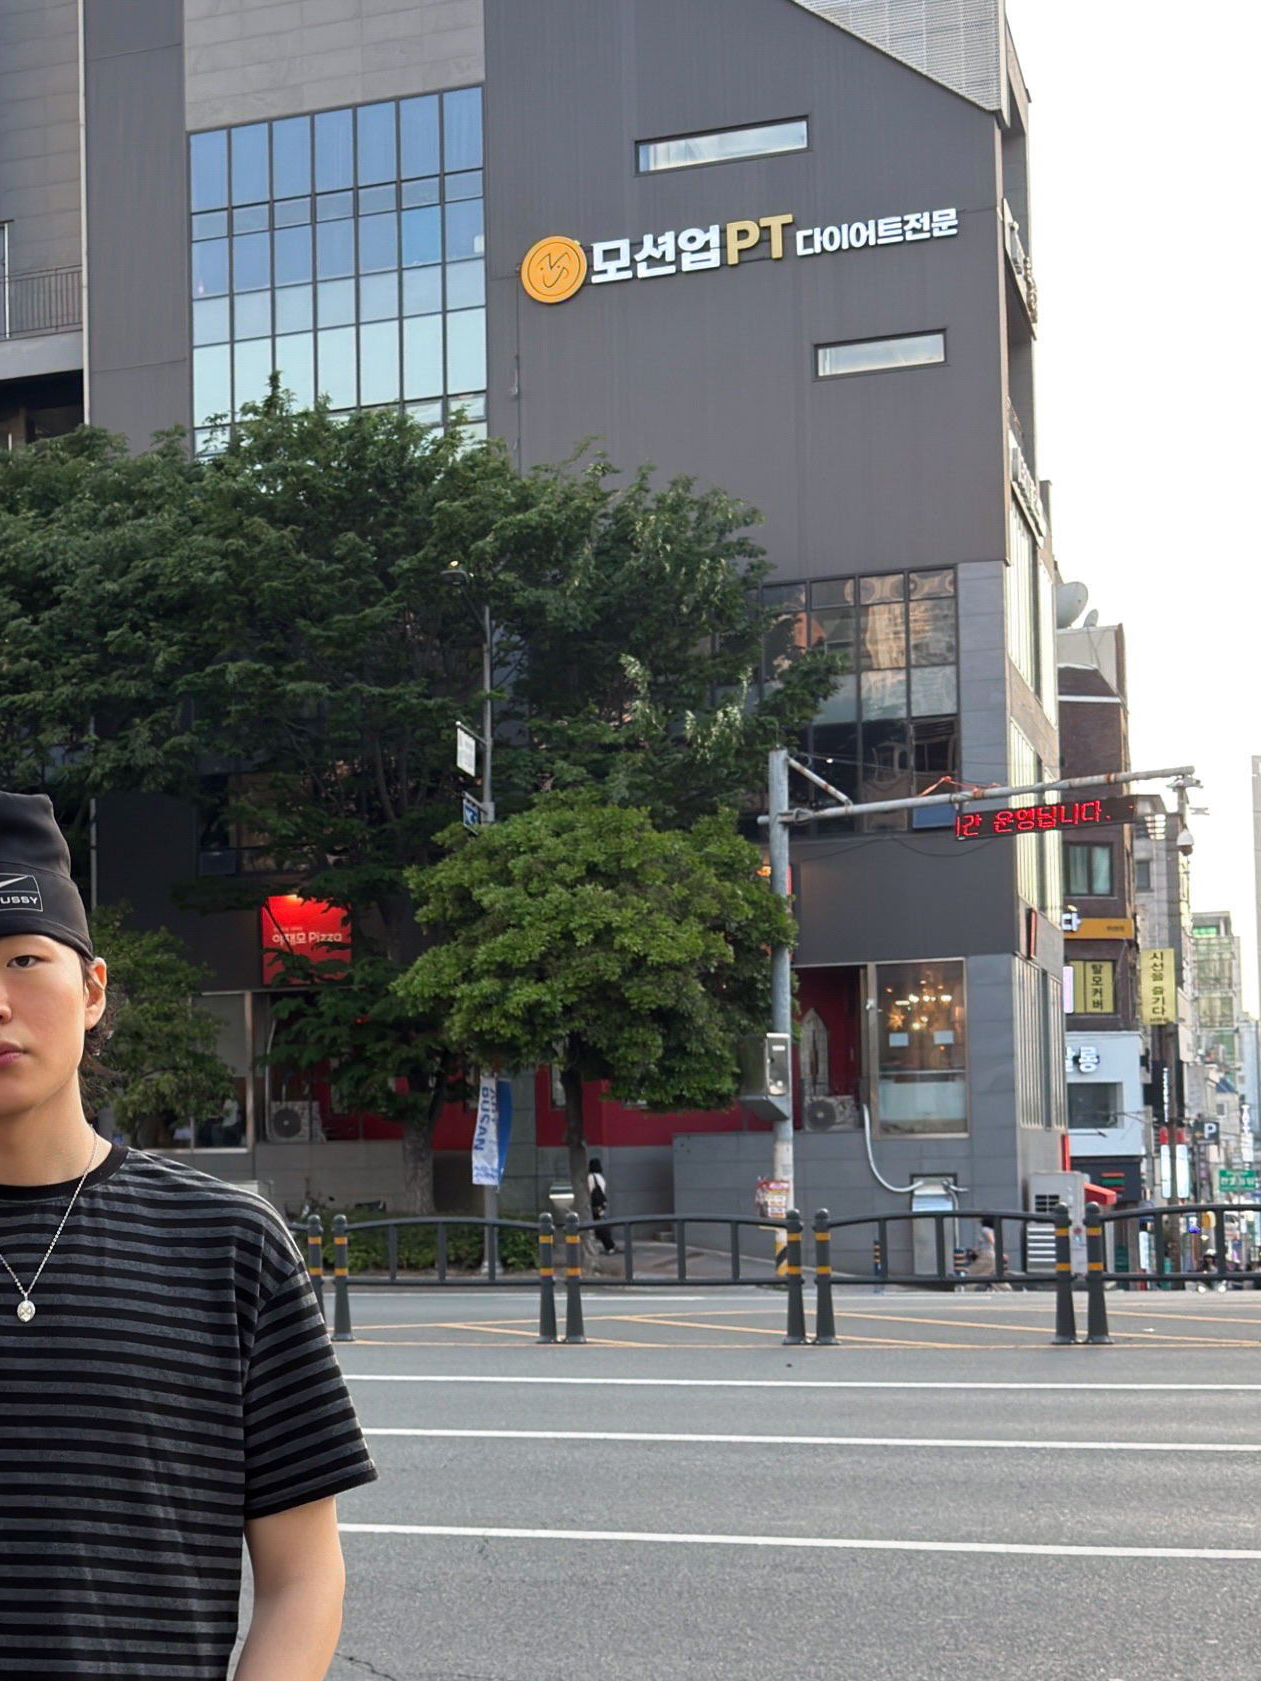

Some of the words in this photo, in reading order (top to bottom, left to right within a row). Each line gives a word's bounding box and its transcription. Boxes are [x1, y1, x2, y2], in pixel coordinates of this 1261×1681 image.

[795, 208, 959, 256] 다이어트전문
[993, 800, 1112, 834] 운영됩니다.
[308, 931, 343, 943] Pizza
[473, 1086, 491, 1151] BUSAN
[1204, 1122, 1217, 1139] P
